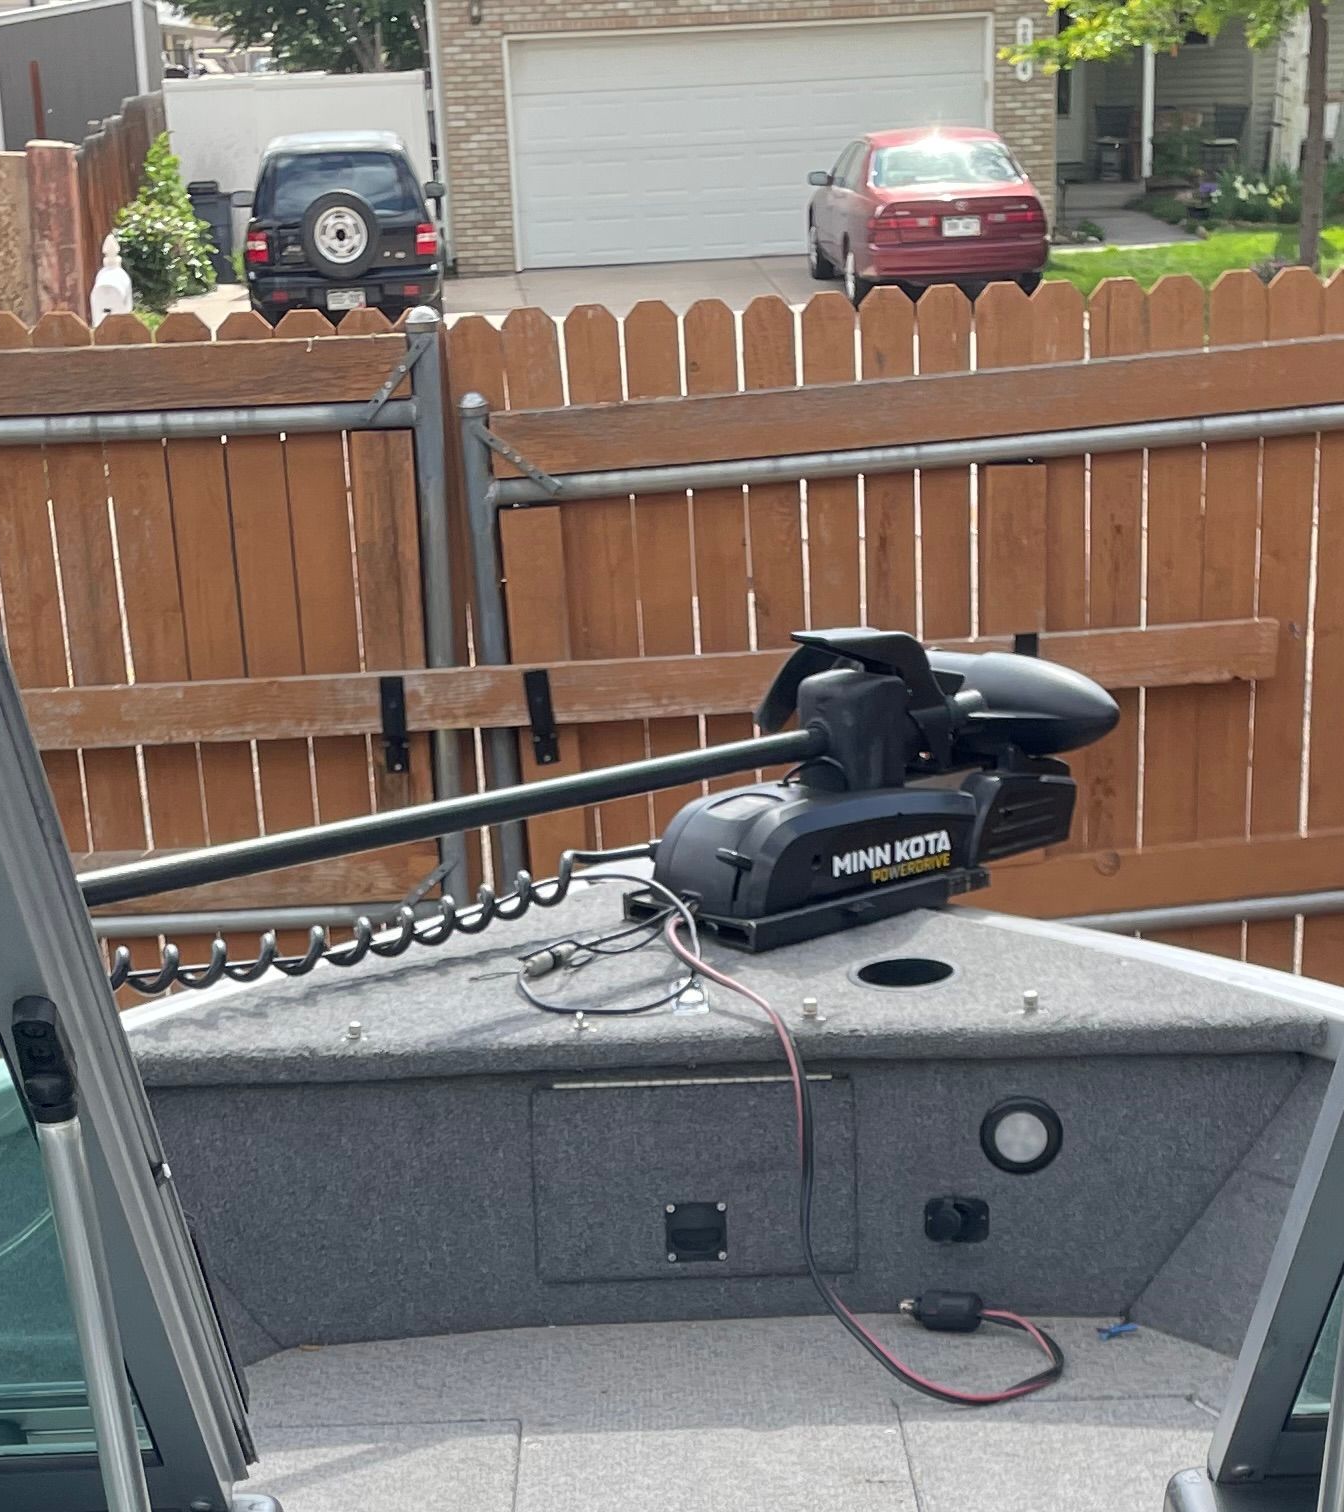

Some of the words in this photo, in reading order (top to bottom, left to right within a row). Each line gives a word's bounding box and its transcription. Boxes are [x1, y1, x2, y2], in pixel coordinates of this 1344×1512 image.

[832, 842, 891, 878] MINN
[894, 829, 952, 862] KOTA
[870, 852, 951, 884] POWERDRIVE
